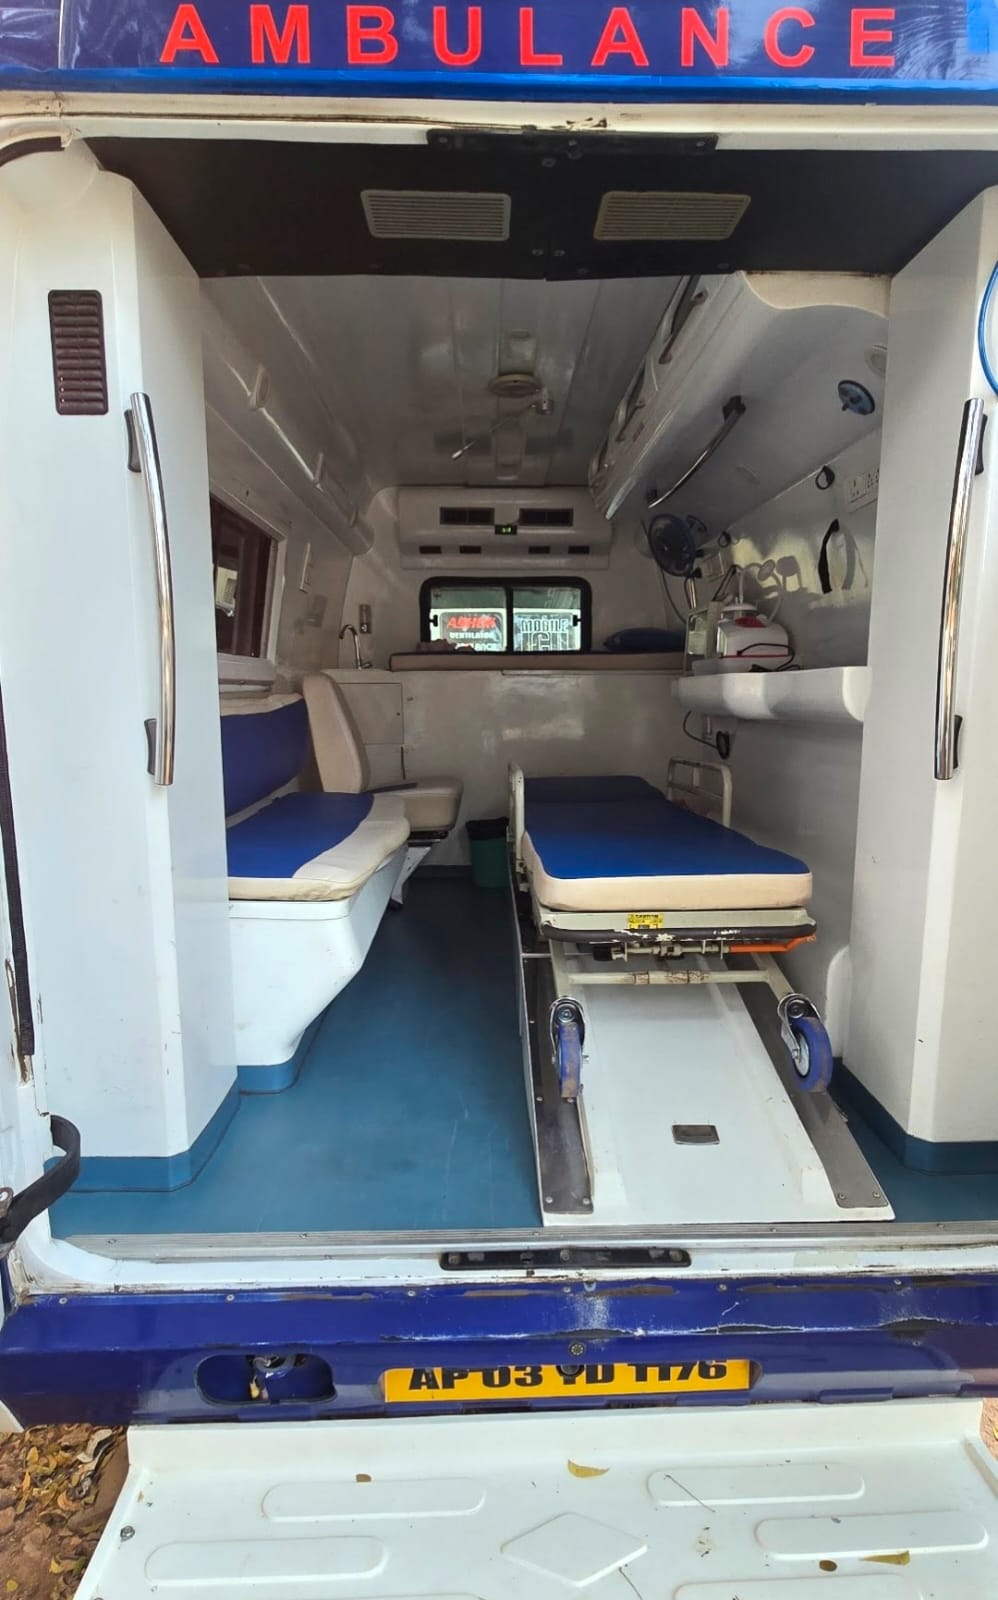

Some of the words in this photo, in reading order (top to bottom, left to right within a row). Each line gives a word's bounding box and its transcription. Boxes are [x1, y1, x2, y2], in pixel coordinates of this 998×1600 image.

[160, 3, 896, 69] AMBULANCE
[520, 618, 569, 633] MOBILE
[409, 1367, 469, 1390] AP
[481, 1365, 543, 1388] 03
